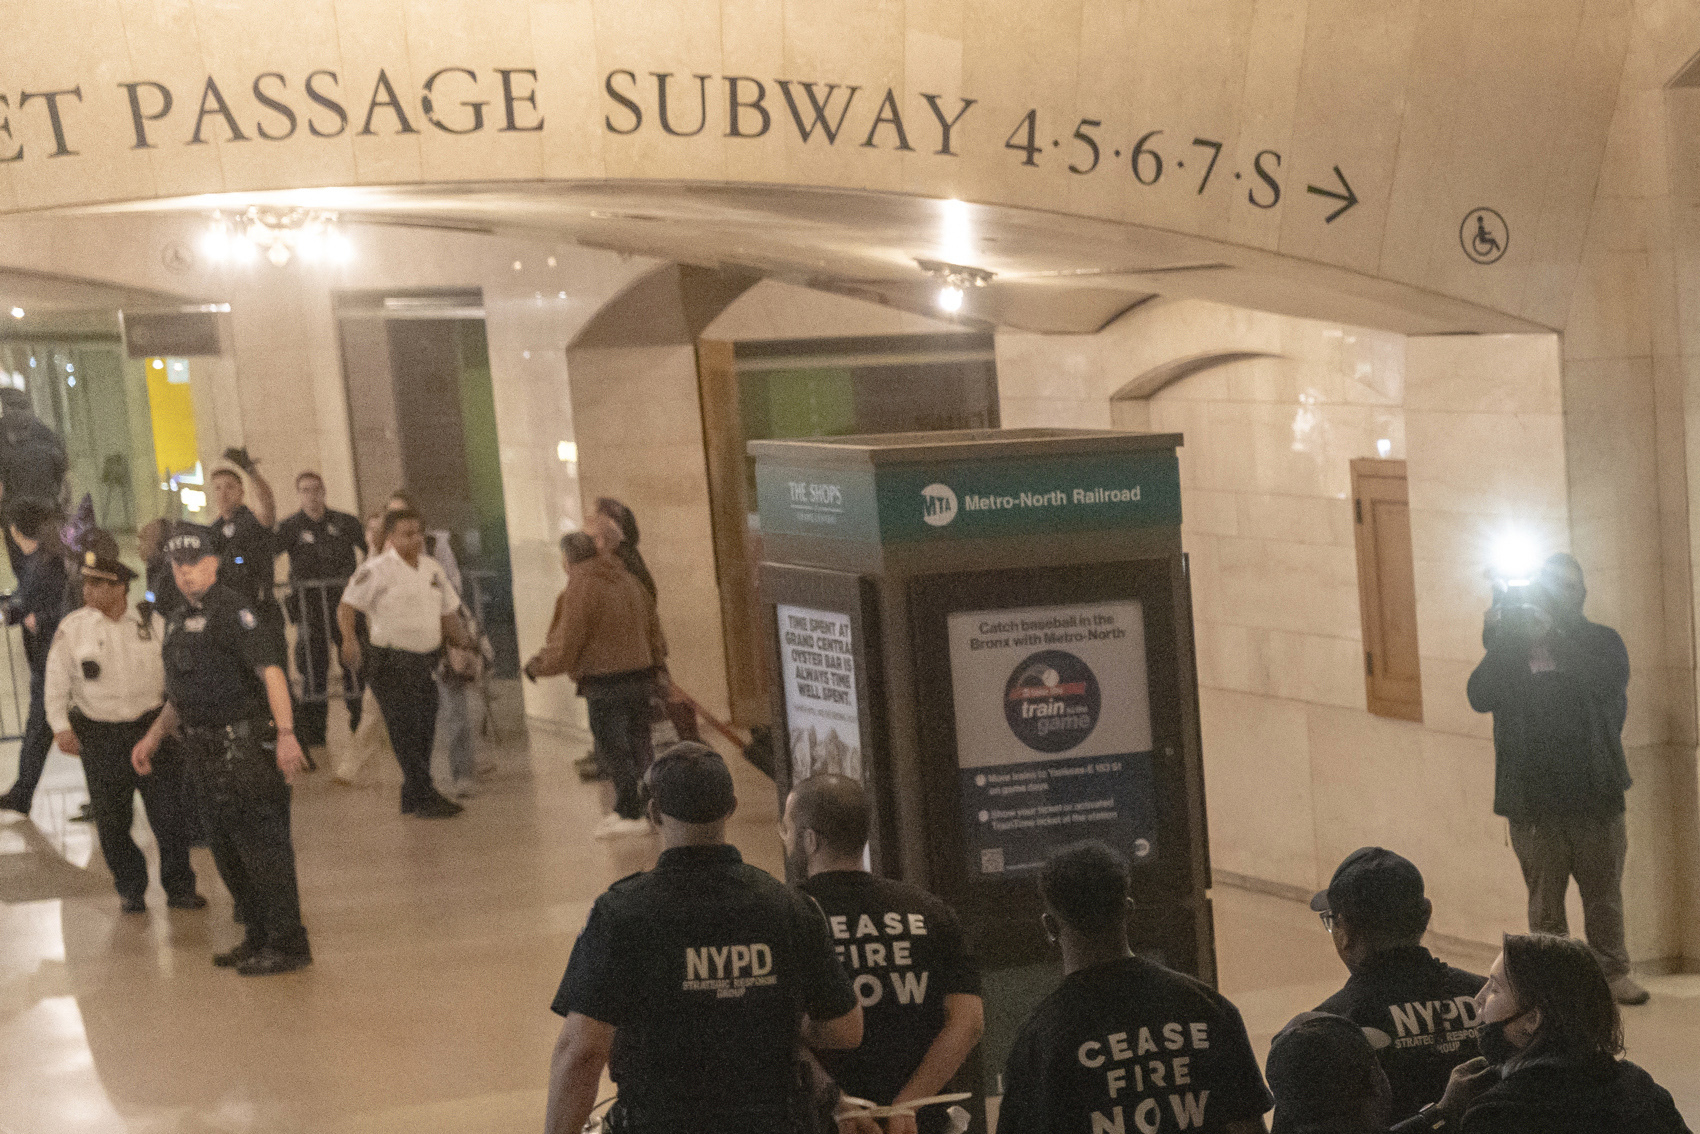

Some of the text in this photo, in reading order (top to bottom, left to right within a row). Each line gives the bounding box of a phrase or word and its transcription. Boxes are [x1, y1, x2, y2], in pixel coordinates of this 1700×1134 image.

[117, 66, 546, 150] PASSAGE
[604, 68, 979, 158] SUBWAY
[788, 481, 842, 505] THE SHOPS
[922, 485, 1142, 518] MTA Metro-North Railroad
[787, 615, 850, 638] TIME SPENT AT
[978, 614, 1115, 635] Catch baseball in the
[785, 631, 852, 656] GRAND CENTRA
[970, 627, 1126, 651] Bronx with Metro-North
[791, 649, 852, 673] OYSTER BAR IS
[795, 665, 852, 690] ALWAYS TIME
[797, 682, 821, 700] WELL
[1021, 698, 1065, 719] train
[1037, 714, 1091, 736] game
[829, 911, 928, 940] EASE
[685, 943, 773, 980] NYPD
[853, 970, 929, 1007] OW
[1388, 995, 1482, 1037] NYPD
[1077, 1021, 1210, 1069] CEASE
[1105, 1056, 1192, 1099] FIRE
